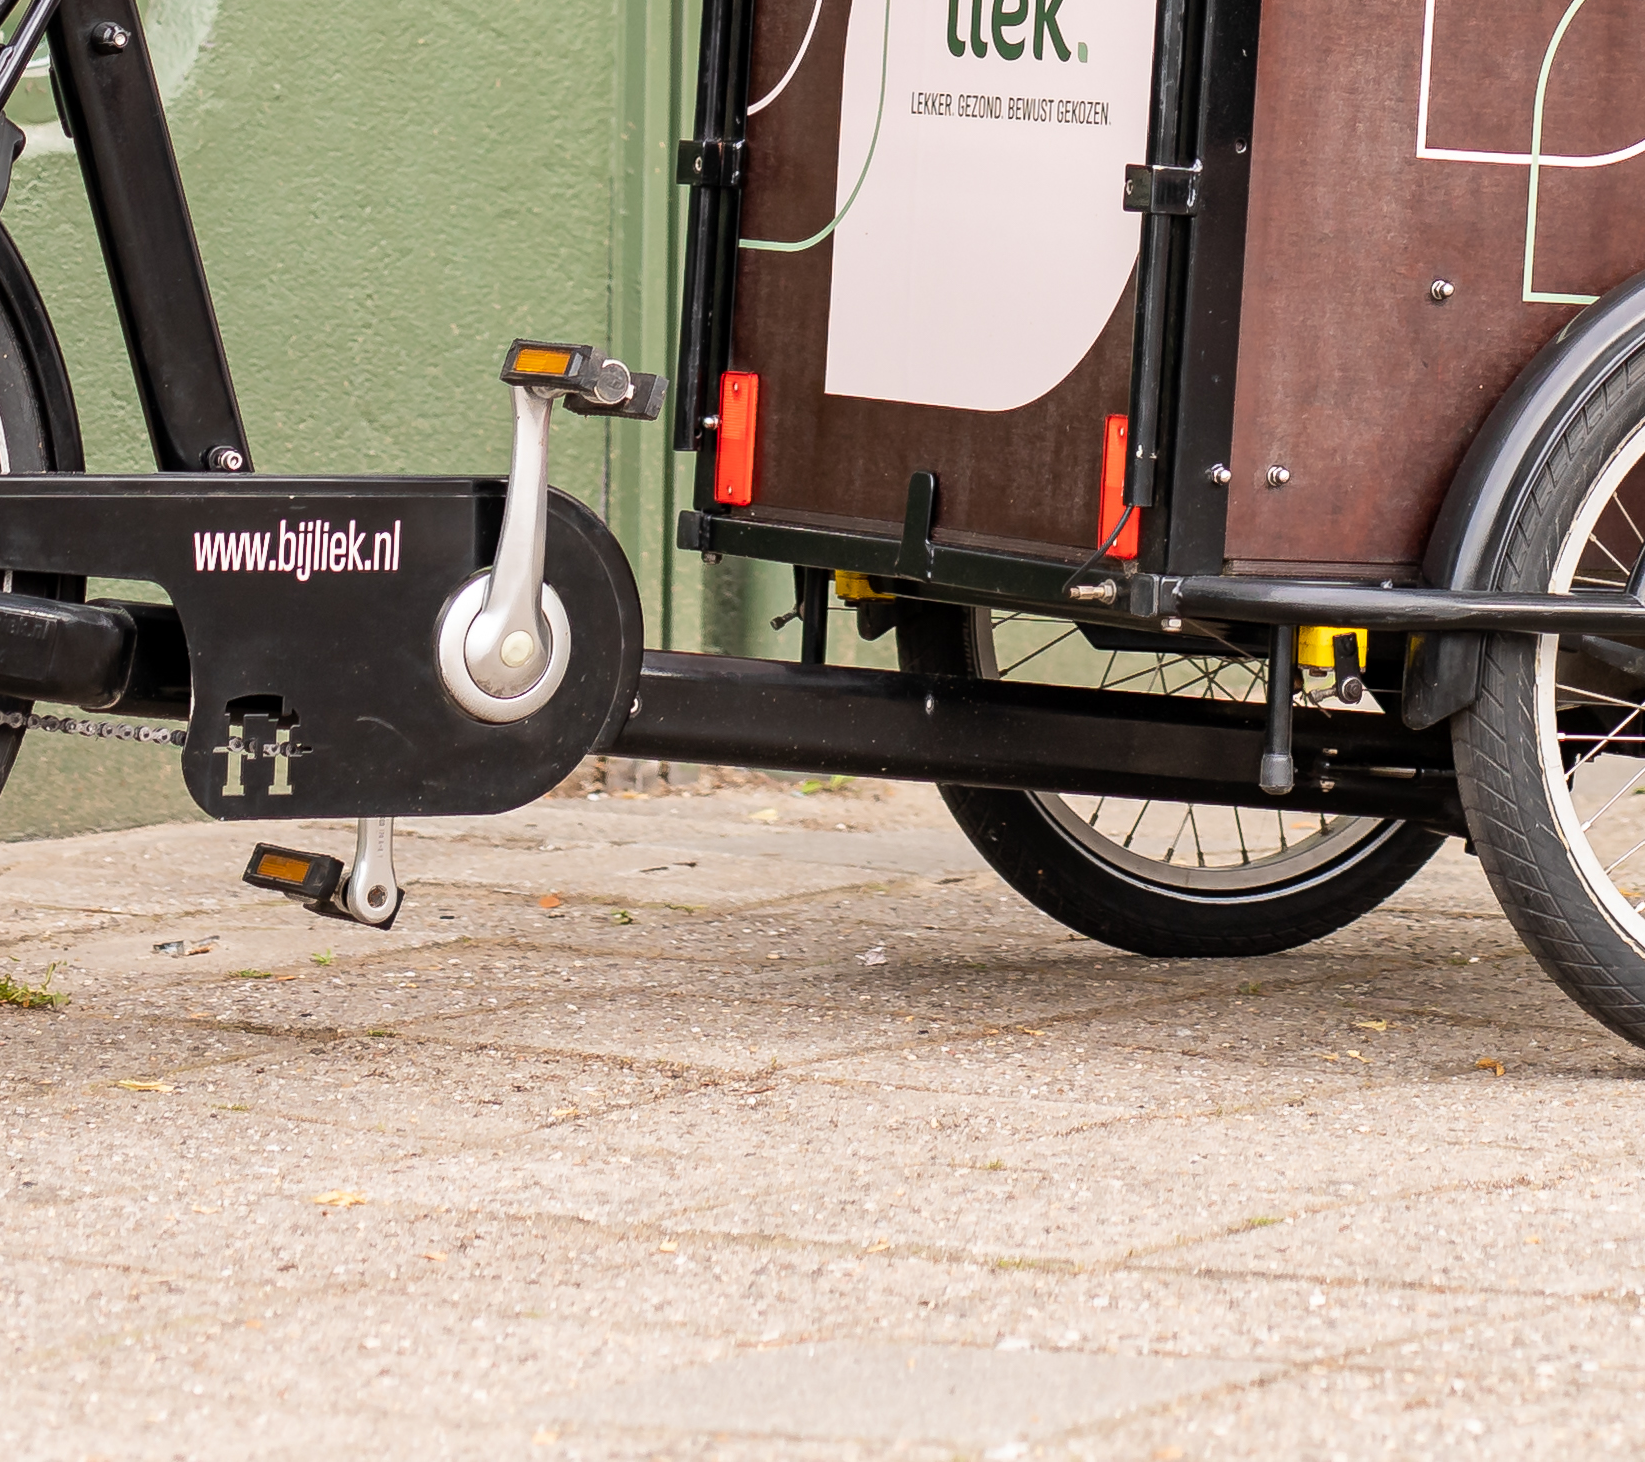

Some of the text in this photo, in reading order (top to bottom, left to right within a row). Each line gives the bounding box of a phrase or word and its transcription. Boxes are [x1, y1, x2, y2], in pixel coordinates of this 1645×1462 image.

[910, 91, 1112, 126] LEKKER. GEZOND. BEWUST GEKOZEN.
[193, 518, 402, 583] www.bijliek.nl
